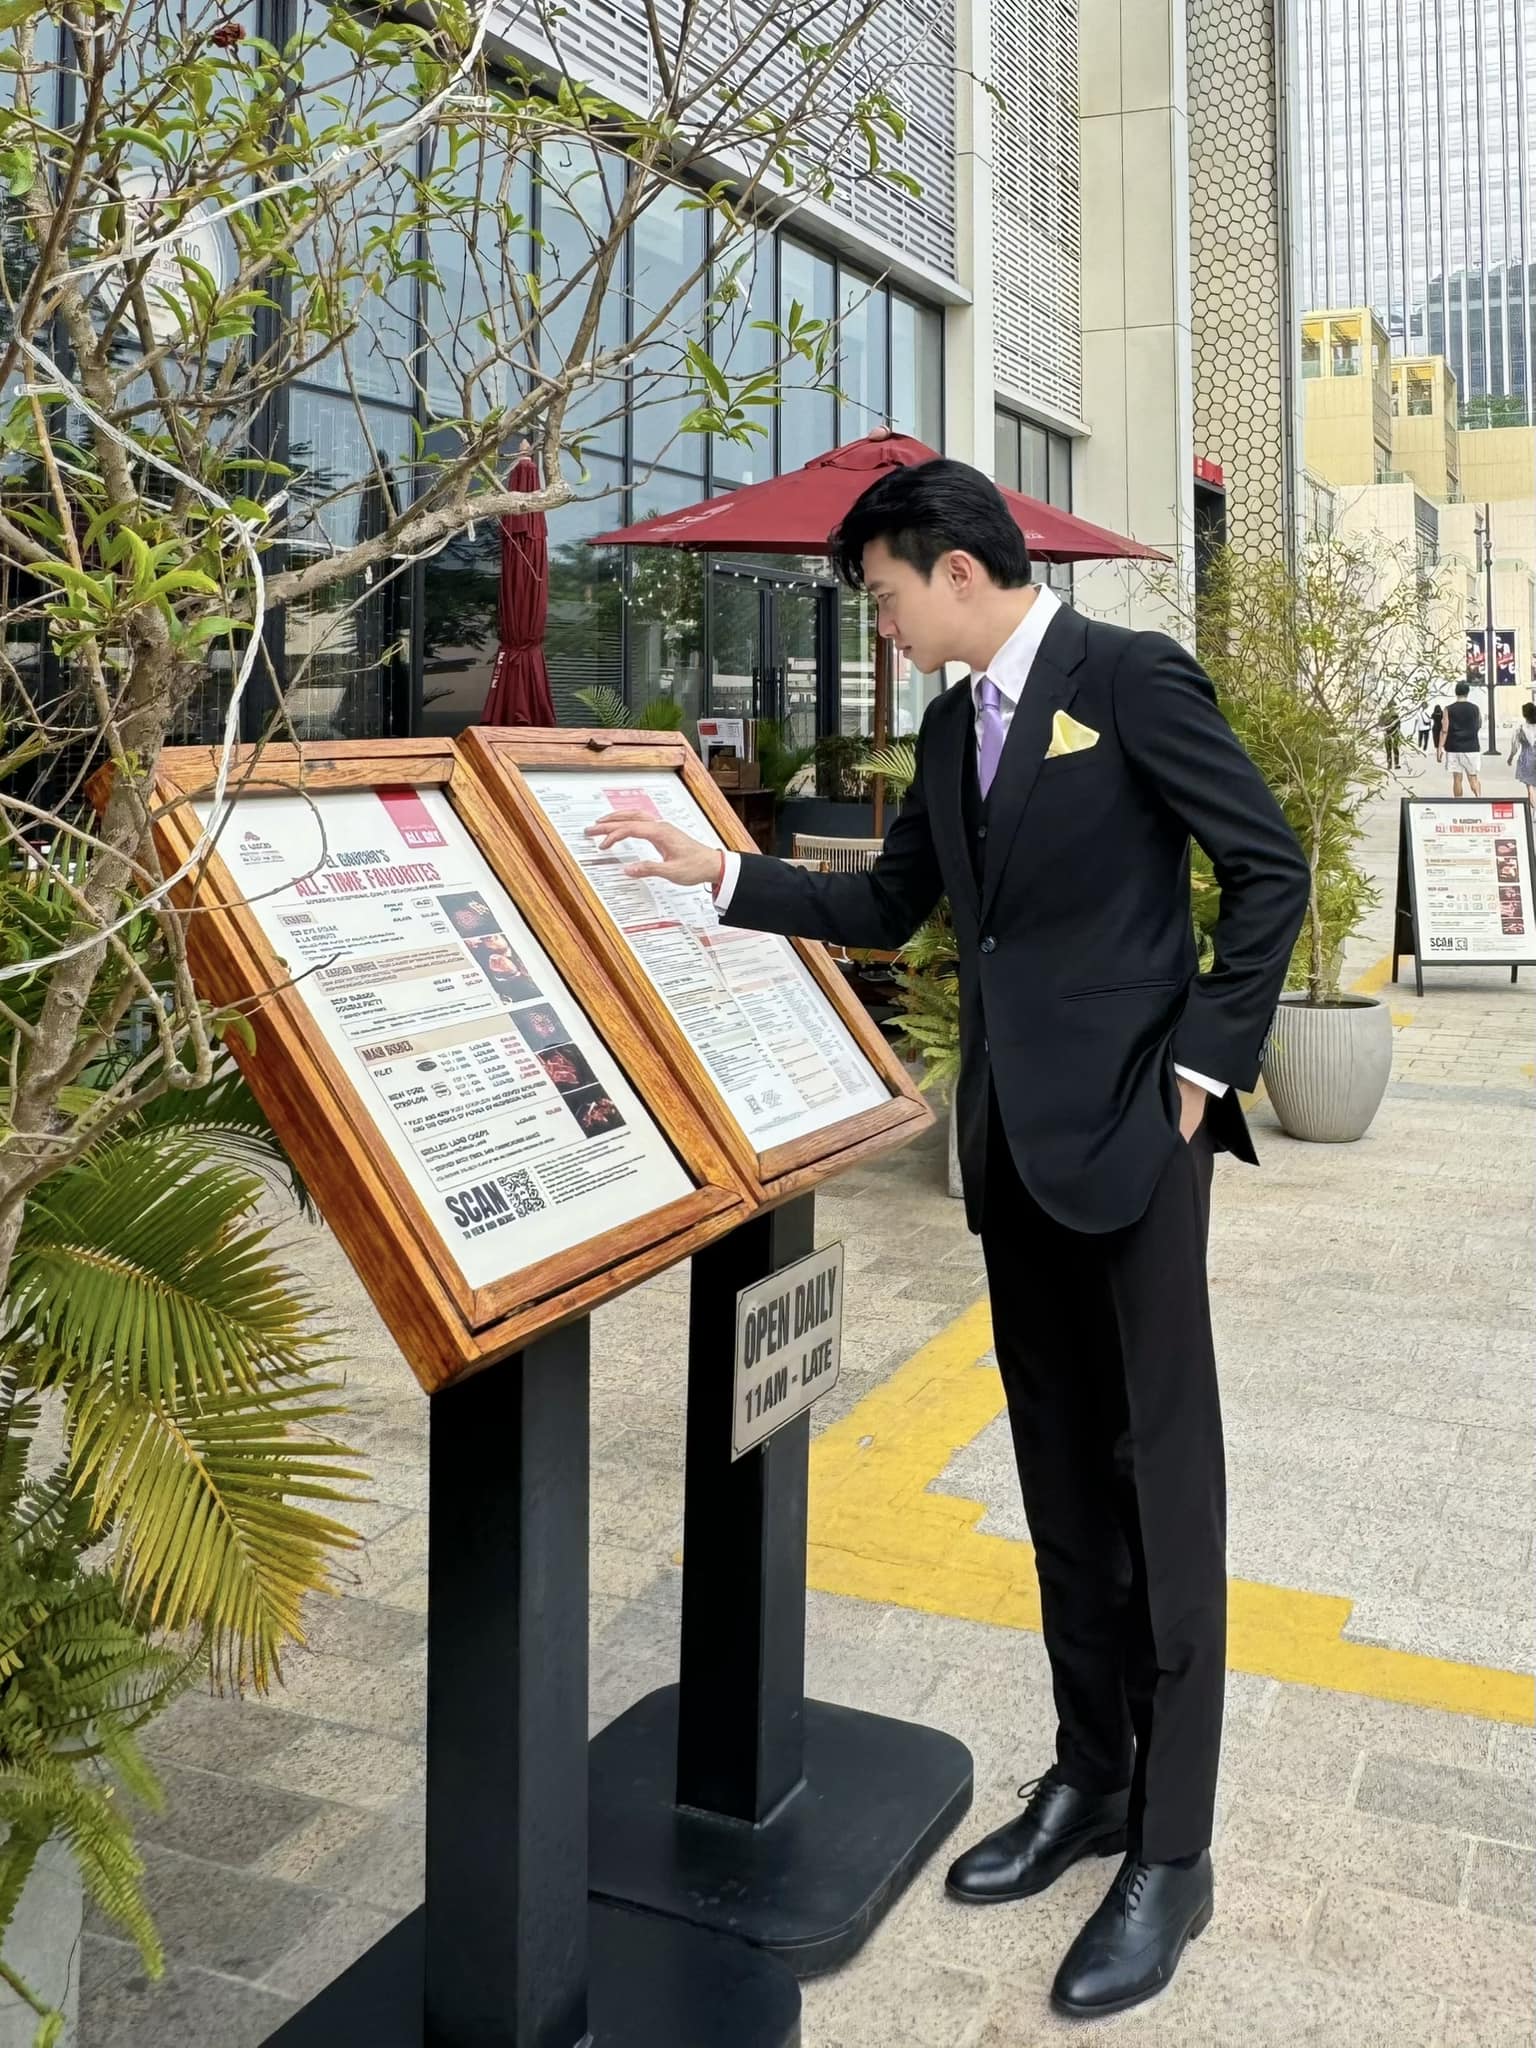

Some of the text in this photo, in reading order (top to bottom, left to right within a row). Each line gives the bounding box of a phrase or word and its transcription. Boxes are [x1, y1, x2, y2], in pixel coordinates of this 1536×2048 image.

[295, 862, 442, 897] ALL-TIME FAVORITES
[1430, 937, 1453, 947] SCAN
[445, 1180, 511, 1228] SCAN
[744, 1265, 838, 1369] OPEN DAILY
[745, 1366, 788, 1424] 11AM
[801, 1338, 833, 1387] LATE
